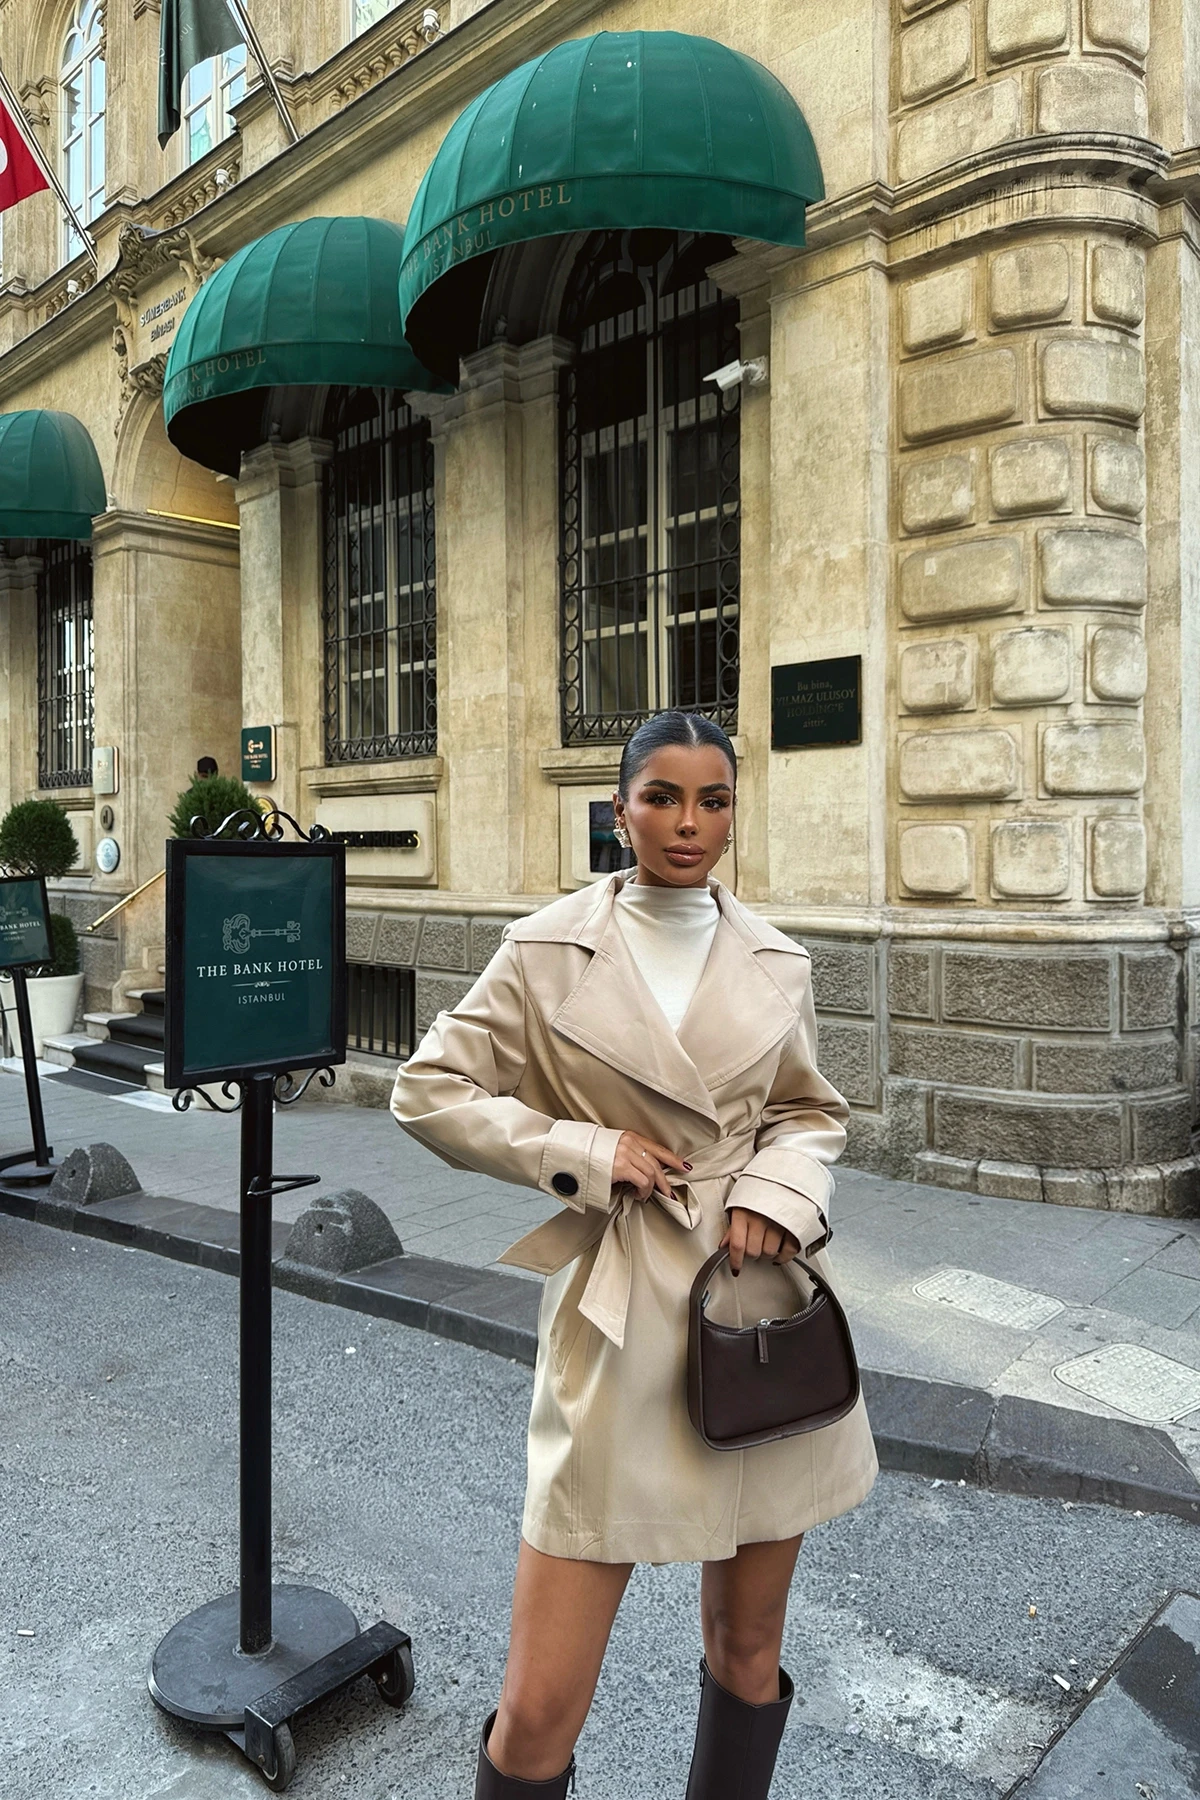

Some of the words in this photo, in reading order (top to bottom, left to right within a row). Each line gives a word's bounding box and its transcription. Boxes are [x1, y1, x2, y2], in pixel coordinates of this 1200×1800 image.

[422, 212, 470, 262] BANK
[479, 184, 573, 226] HOTEL
[428, 230, 495, 282] ISTNBUL
[205, 349, 267, 377] HOTEL
[797, 681, 809, 691] Bu
[816, 688, 856, 701] ULUSOY
[197, 964, 228, 978] THE
[233, 962, 273, 975] BANK
[277, 958, 323, 972] HOTEL
[238, 993, 285, 1004] ISTANBUL
